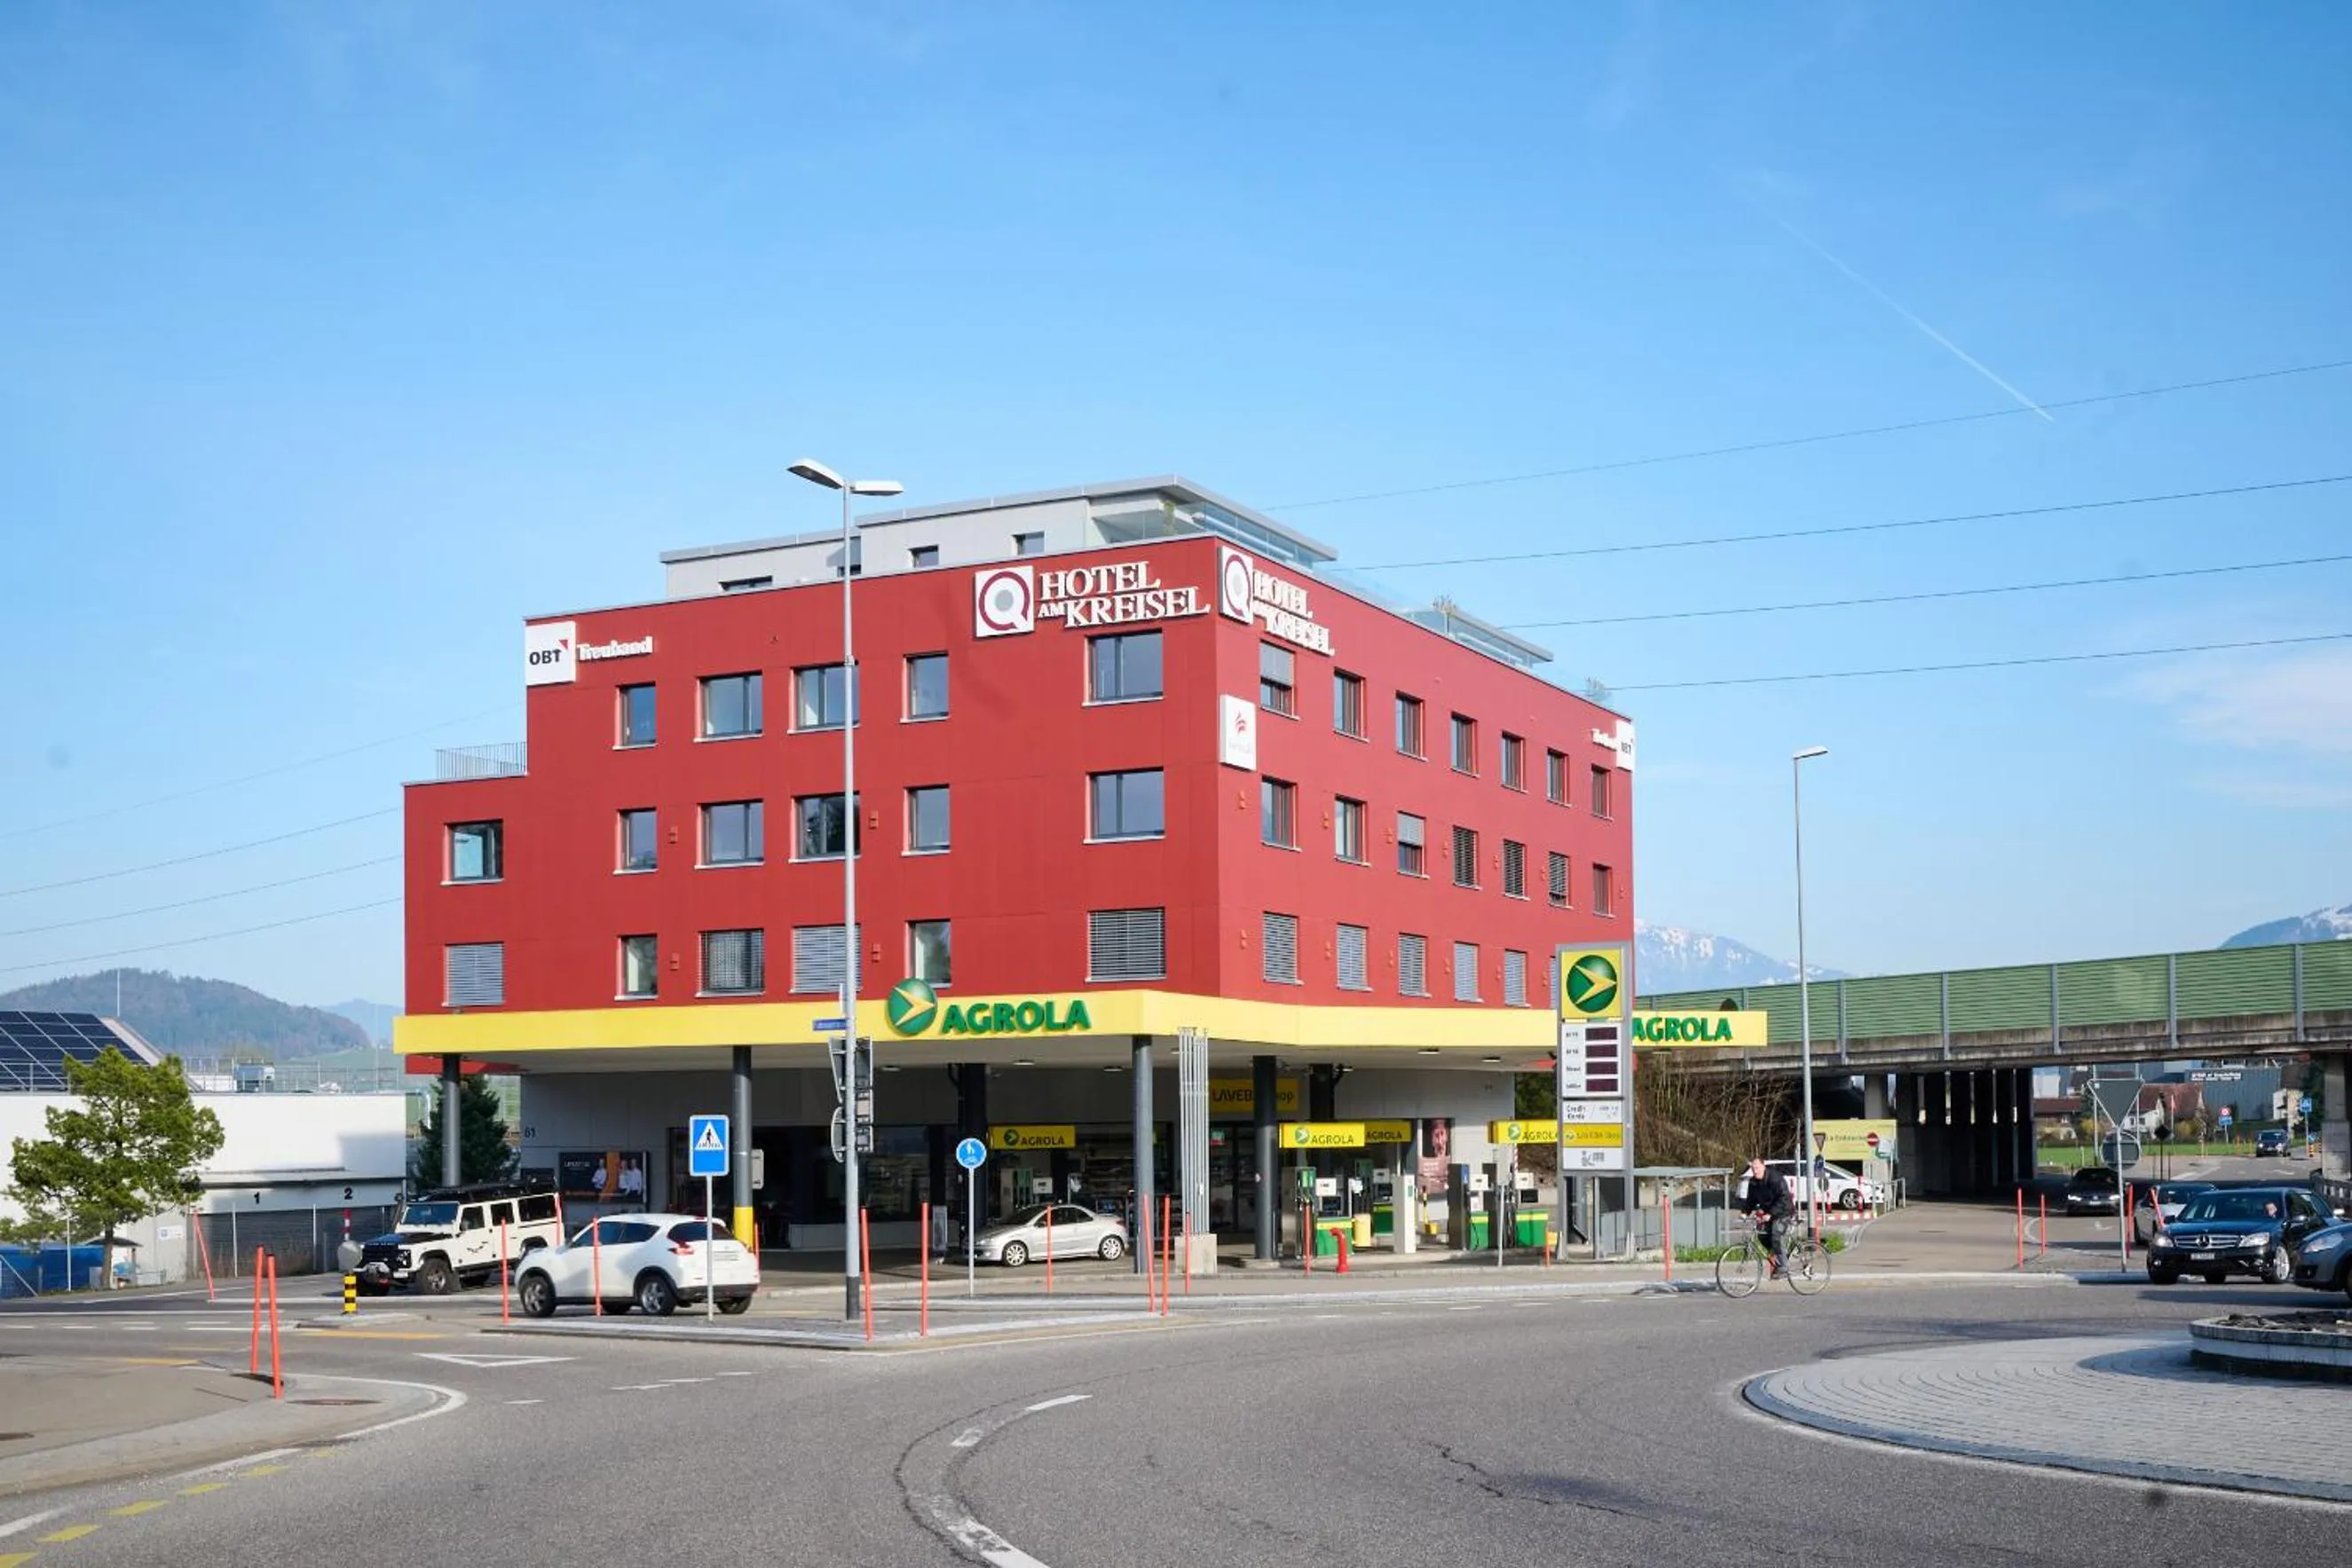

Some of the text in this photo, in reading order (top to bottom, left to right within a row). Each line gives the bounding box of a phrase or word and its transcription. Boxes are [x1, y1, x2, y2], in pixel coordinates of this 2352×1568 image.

[1039, 561, 1161, 601] HOTEL
[1252, 569, 1314, 619] HOTEL
[1038, 587, 1212, 628] AM KREISEL
[529, 649, 562, 666] OBT
[578, 636, 653, 661] Treuhand
[940, 999, 1092, 1036] AGROLA
[1632, 1017, 1732, 1042] AGROLA
[1212, 1088, 1254, 1102] LAVEB
[1021, 1136, 1065, 1146] AGROLA
[1311, 1134, 1354, 1145] AGROLA
[1366, 1131, 1402, 1140] AGROLA
[254, 1187, 353, 1204] 1 2
